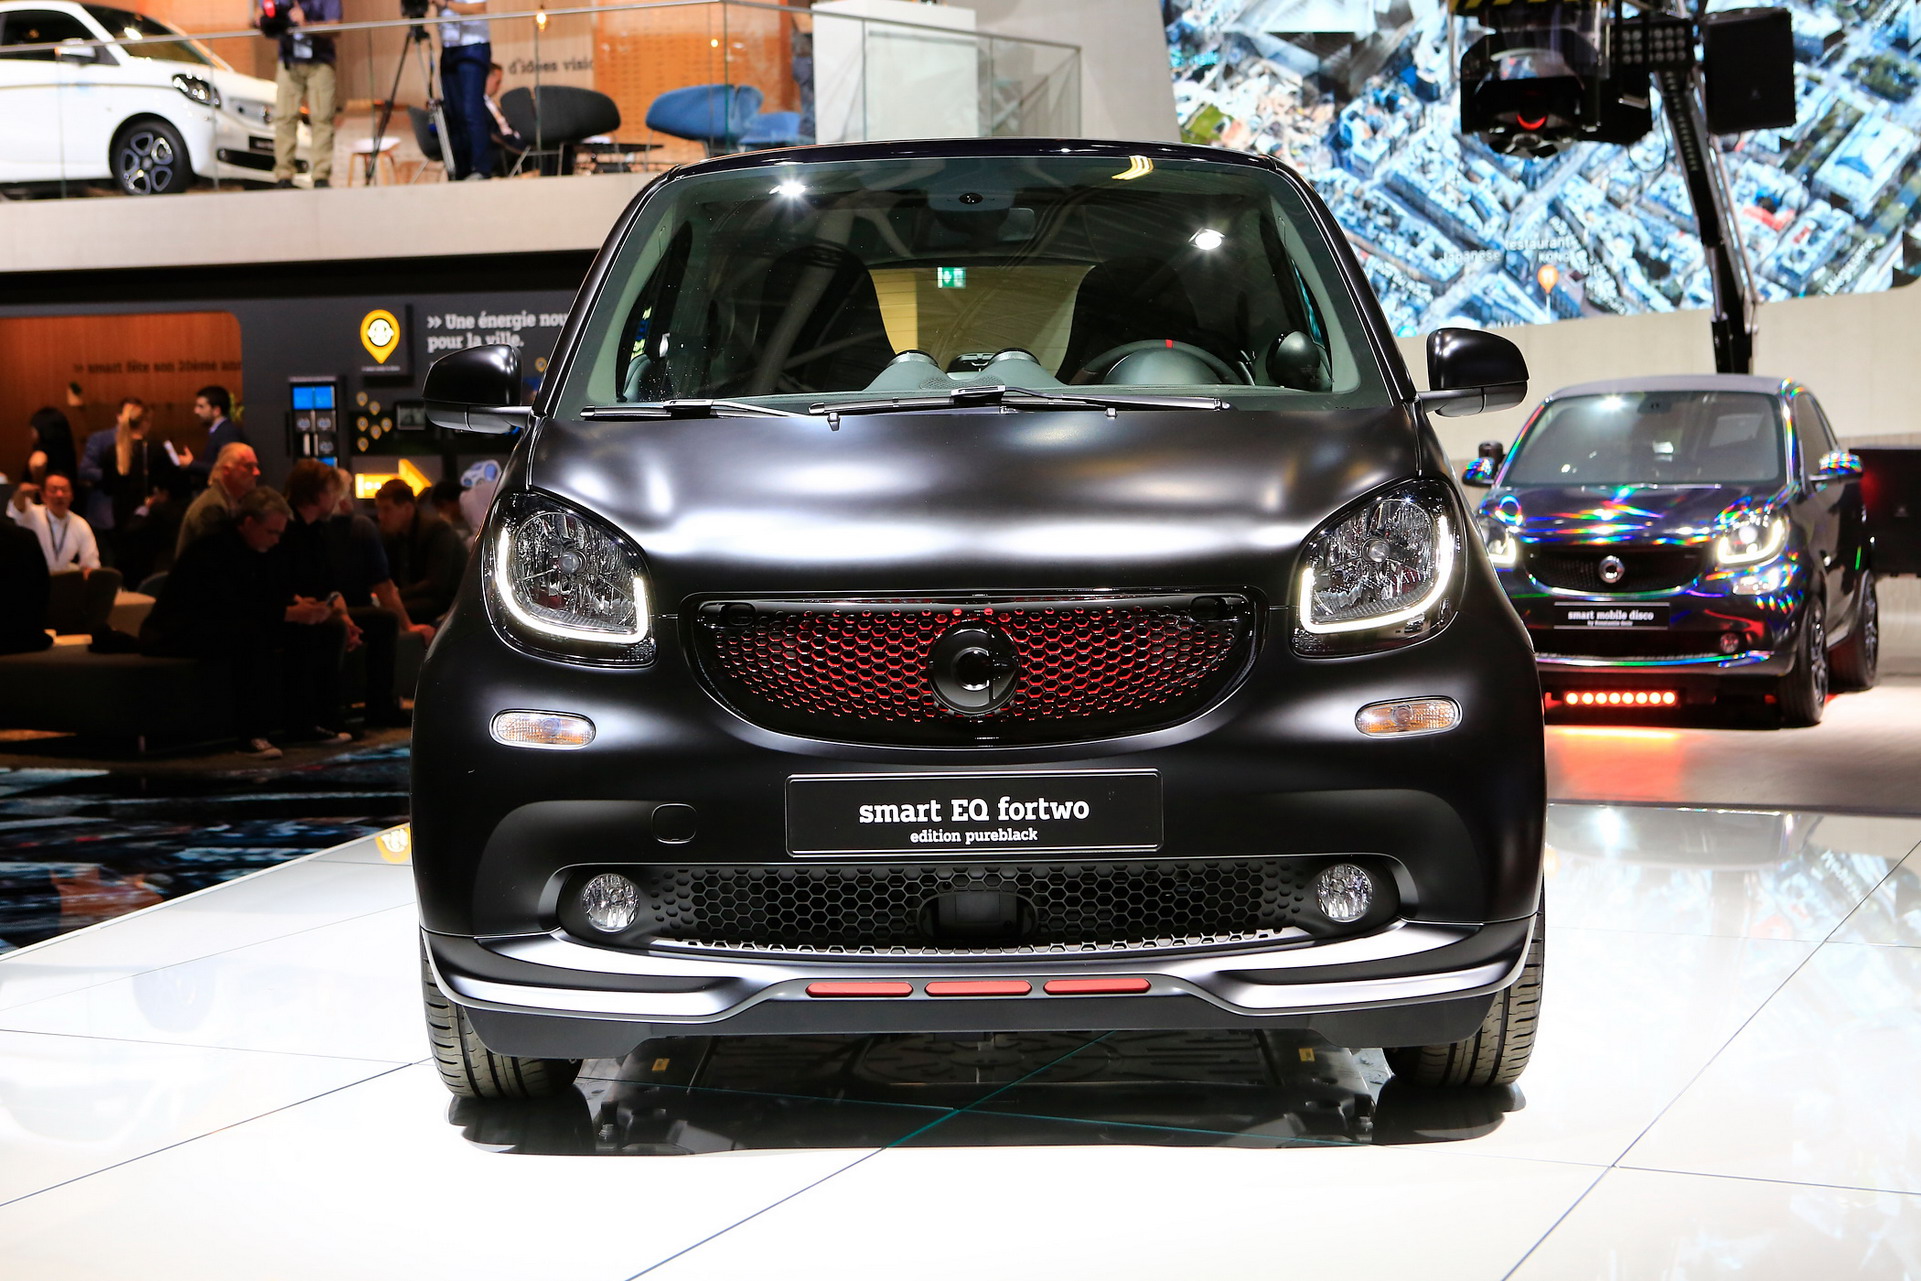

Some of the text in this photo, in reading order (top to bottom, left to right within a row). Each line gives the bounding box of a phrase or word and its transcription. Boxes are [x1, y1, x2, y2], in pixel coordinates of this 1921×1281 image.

[445, 313, 475, 329] Une
[478, 310, 536, 331] énergie
[427, 335, 463, 353] pour
[466, 332, 482, 349] la
[1568, 609, 1654, 621] smart mobile disco
[859, 796, 1090, 824] smart EQ fortwo
[910, 827, 1038, 845] edition pureblack
